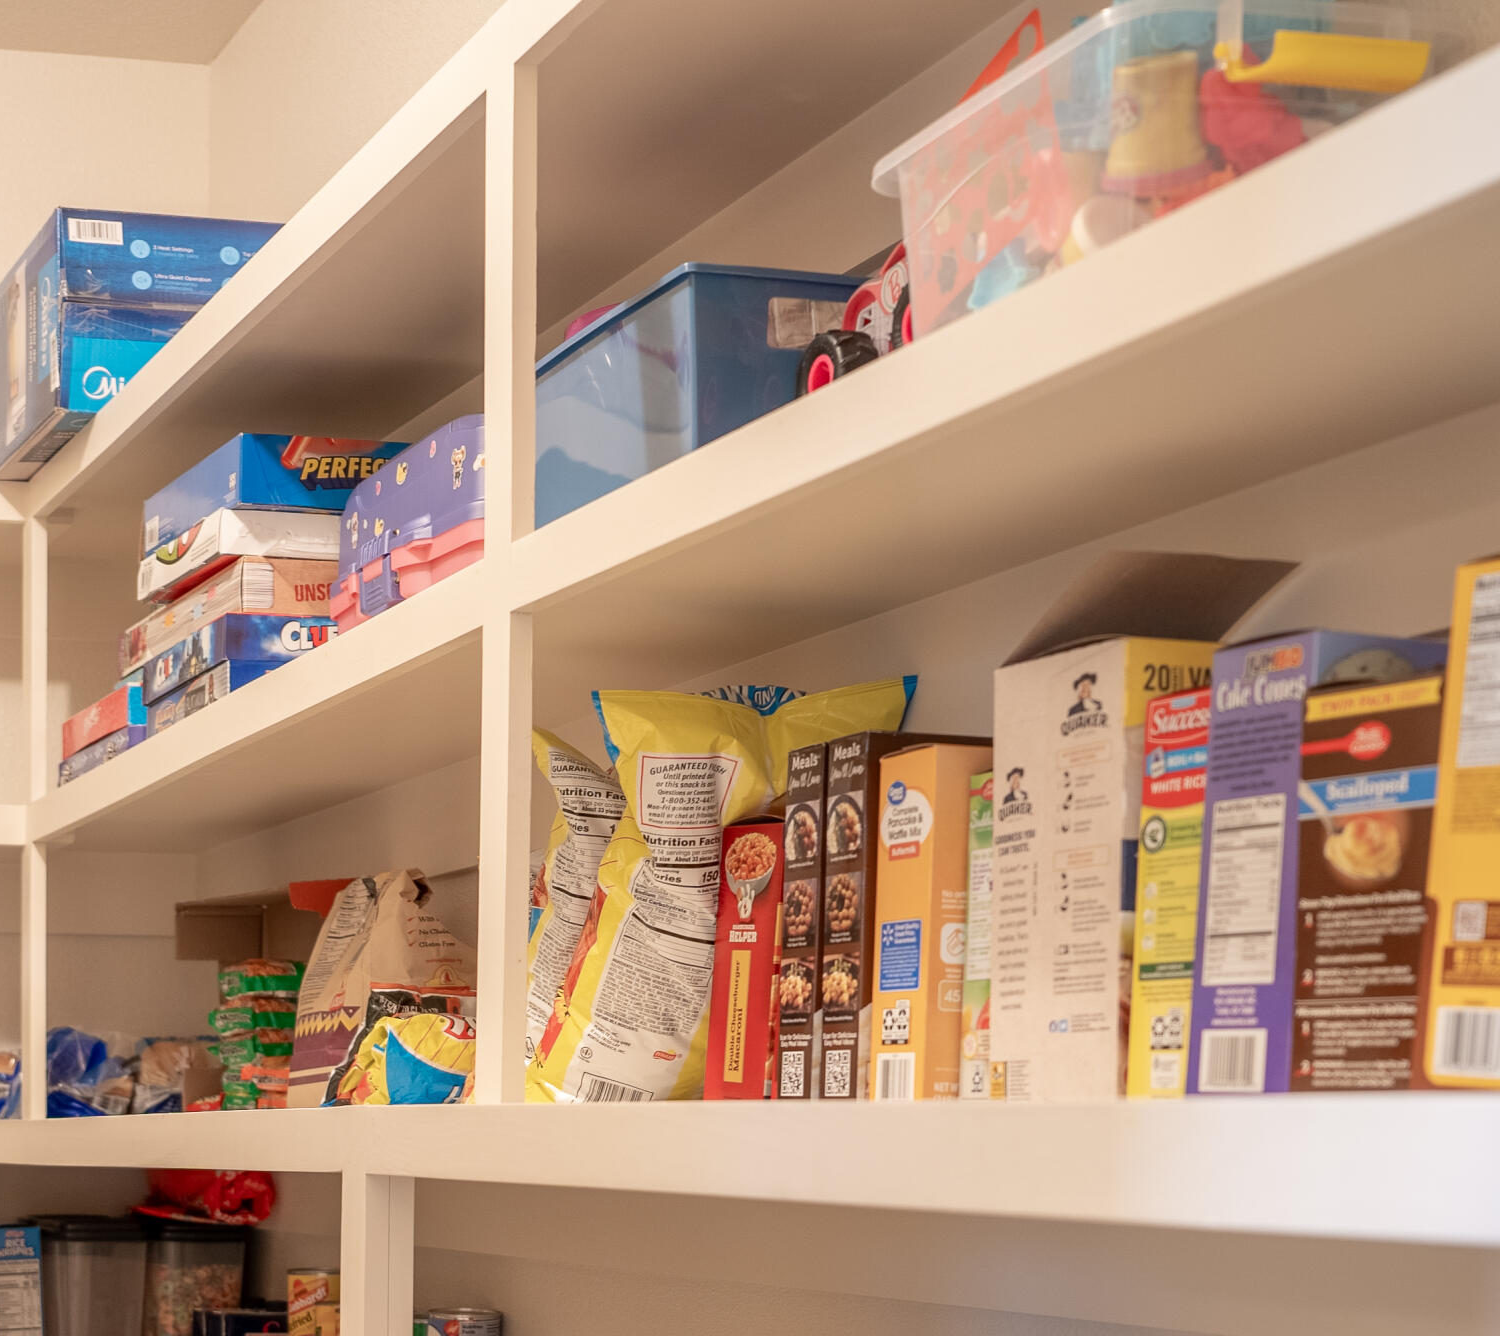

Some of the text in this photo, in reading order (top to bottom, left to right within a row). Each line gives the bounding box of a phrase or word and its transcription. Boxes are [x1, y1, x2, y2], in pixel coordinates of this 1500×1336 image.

[1143, 665, 1170, 691] 20
[1060, 712, 1109, 737] QUAKER
[1152, 707, 1211, 737] Succes
[834, 742, 861, 762] Meals
[649, 762, 708, 776] GUARANTEED
[792, 752, 818, 771] Meals
[556, 787, 602, 798] utrition
[1326, 771, 1410, 801] Scalloped
[999, 802, 1033, 822] QUAKER
[888, 814, 917, 829] Pancake
[643, 834, 696, 847] Nutrition
[888, 827, 922, 841] Waffle Mix
[702, 869, 719, 883] 150
[729, 931, 757, 943] HELPER
[733, 1007, 743, 1072] Macaroni
[5, 1239, 26, 1248] RICE
